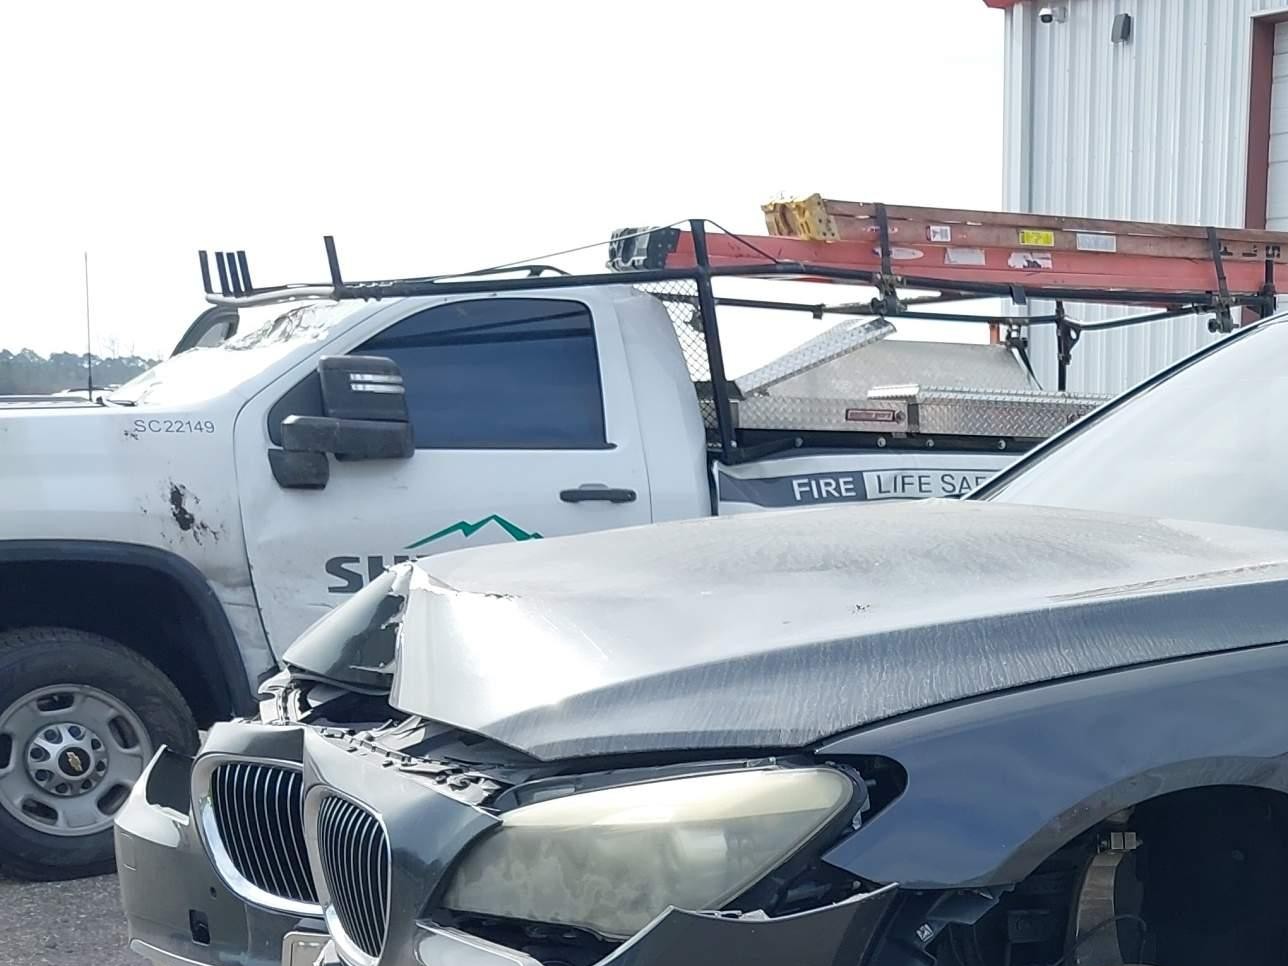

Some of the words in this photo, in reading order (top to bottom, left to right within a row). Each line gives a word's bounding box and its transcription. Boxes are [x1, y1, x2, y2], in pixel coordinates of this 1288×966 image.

[133, 419, 215, 433] SC22149
[792, 477, 857, 501] FIRE
[876, 474, 932, 494] LIFE
